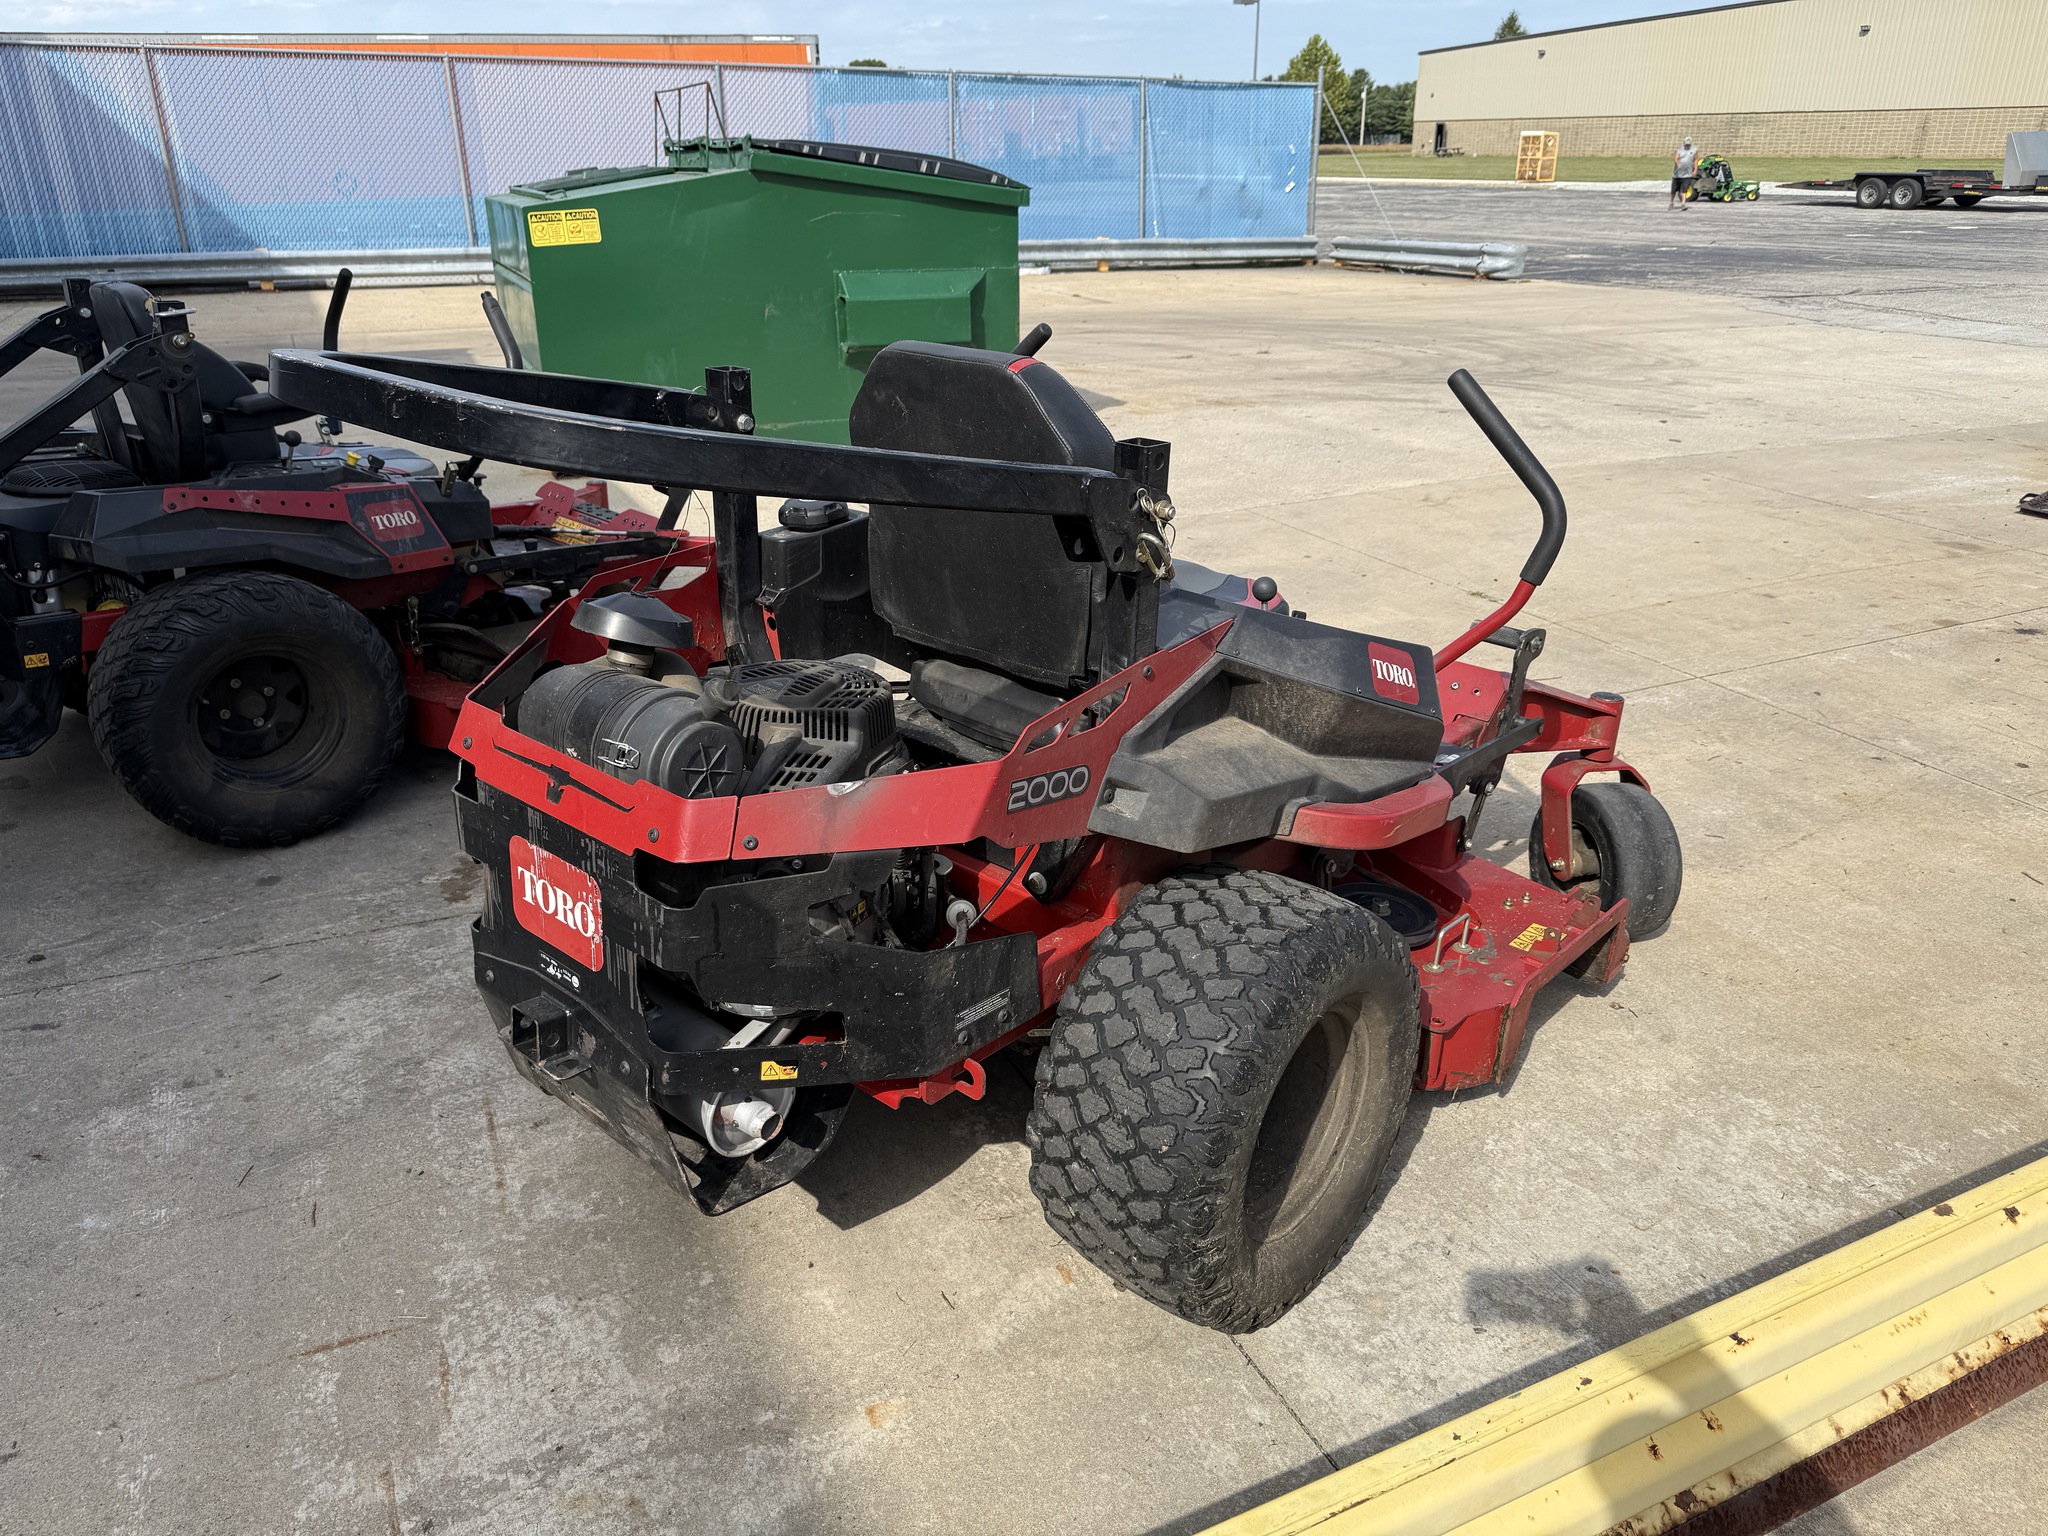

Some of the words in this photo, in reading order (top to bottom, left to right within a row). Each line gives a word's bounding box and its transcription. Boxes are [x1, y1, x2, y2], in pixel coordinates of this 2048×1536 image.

[371, 510, 417, 531] TORO
[1372, 658, 1414, 688] TORO
[1008, 766, 1089, 810] 2000
[517, 865, 596, 938] TORO
